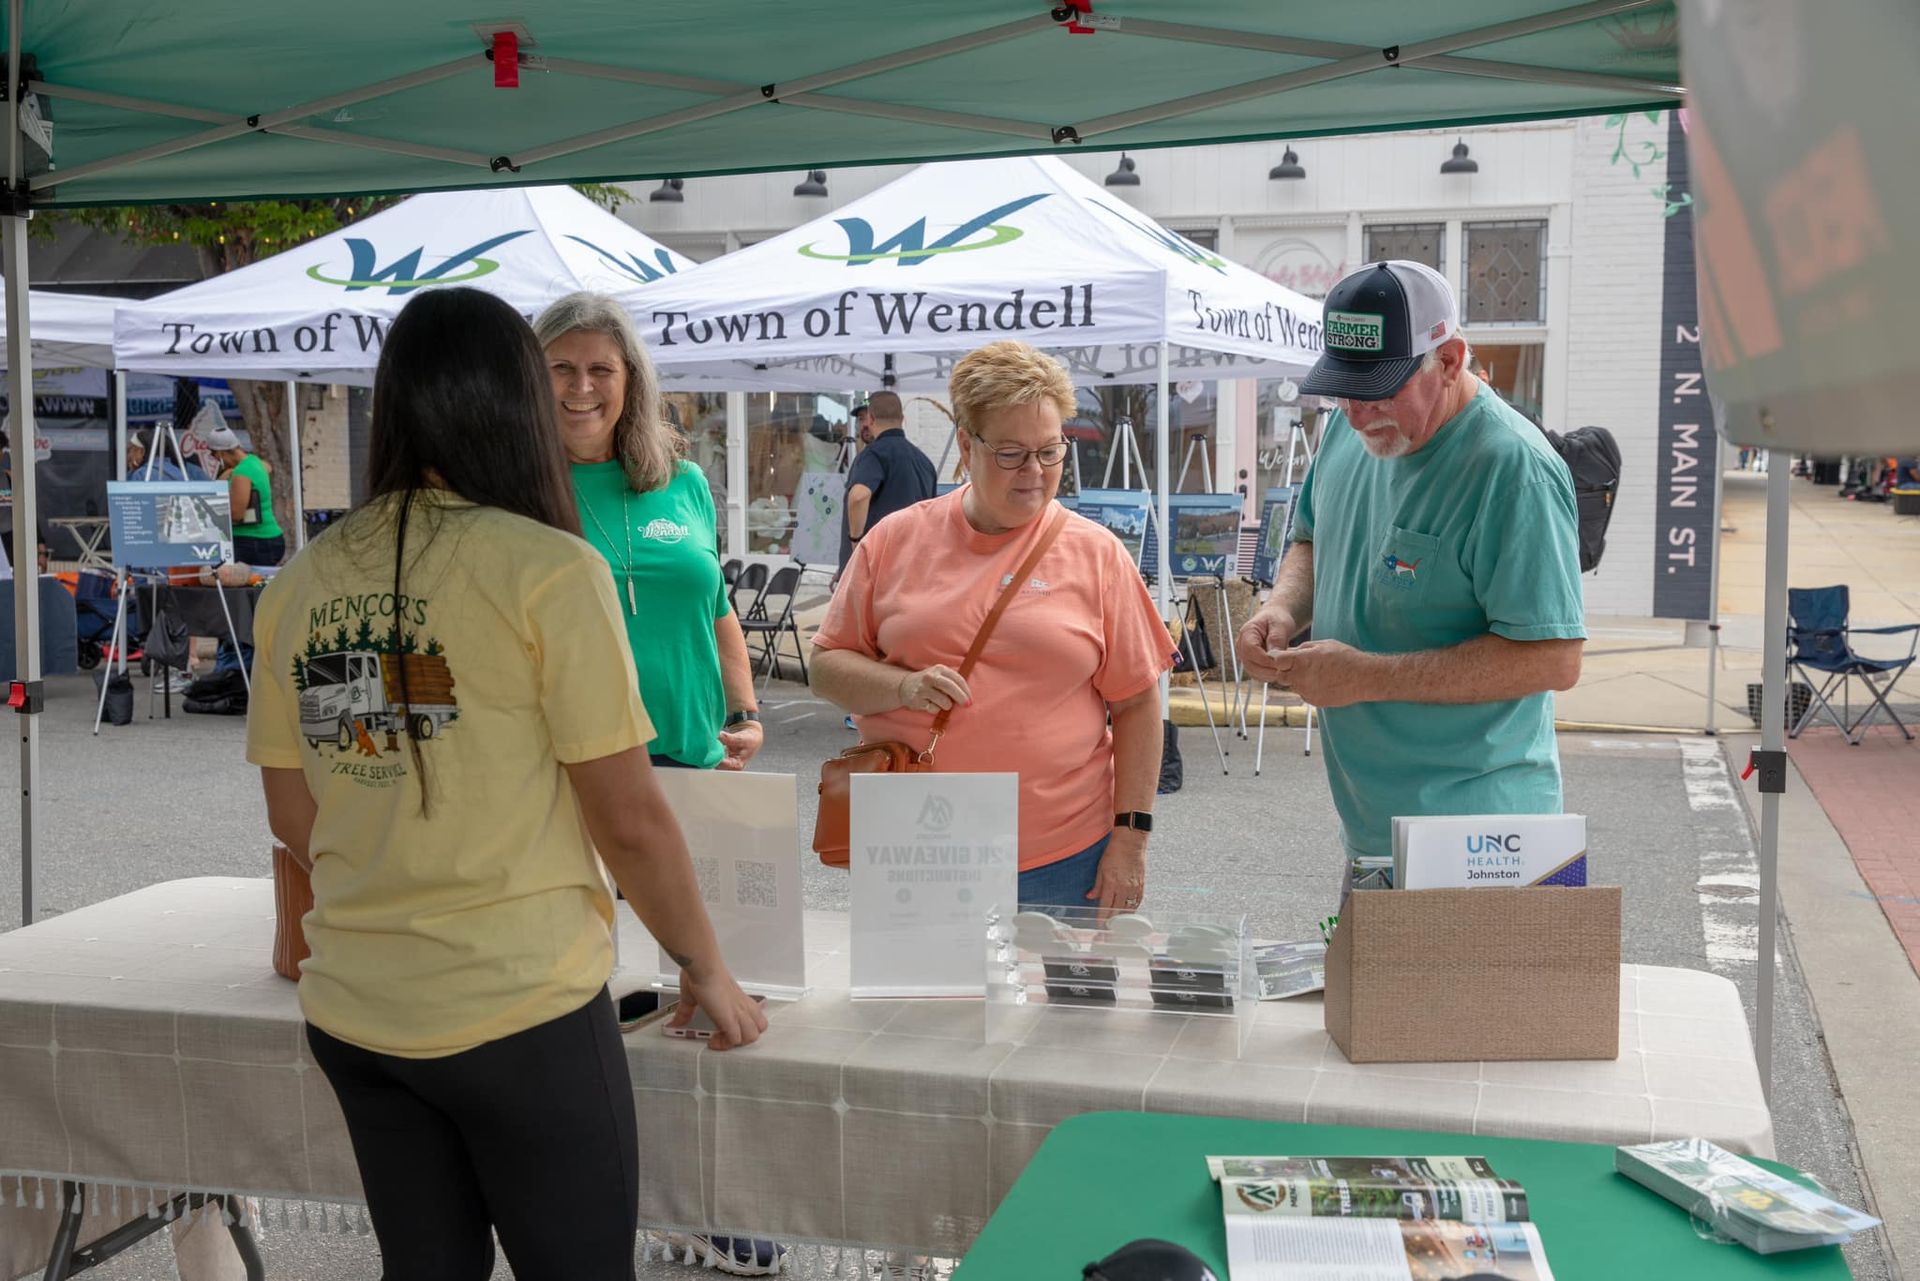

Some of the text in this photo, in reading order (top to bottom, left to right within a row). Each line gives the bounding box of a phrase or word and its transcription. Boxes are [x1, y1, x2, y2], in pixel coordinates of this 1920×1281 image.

[653, 283, 1096, 346] Town of Wendell
[1188, 289, 1251, 339] Town
[1255, 301, 1273, 343] of
[162, 322, 280, 355] Town
[294, 313, 342, 352] of
[1328, 320, 1379, 337] FARMER
[1328, 333, 1377, 349] STRONG
[1667, 325, 1702, 574] 2 N. MAIN ST.
[225, 548, 232, 560] 5
[308, 592, 429, 634] MENCOR'S
[331, 761, 368, 778] TREE
[1466, 833, 1521, 854] UNC
[1467, 856, 1521, 867] HEALTH
[1466, 869, 1521, 880] Johnston
